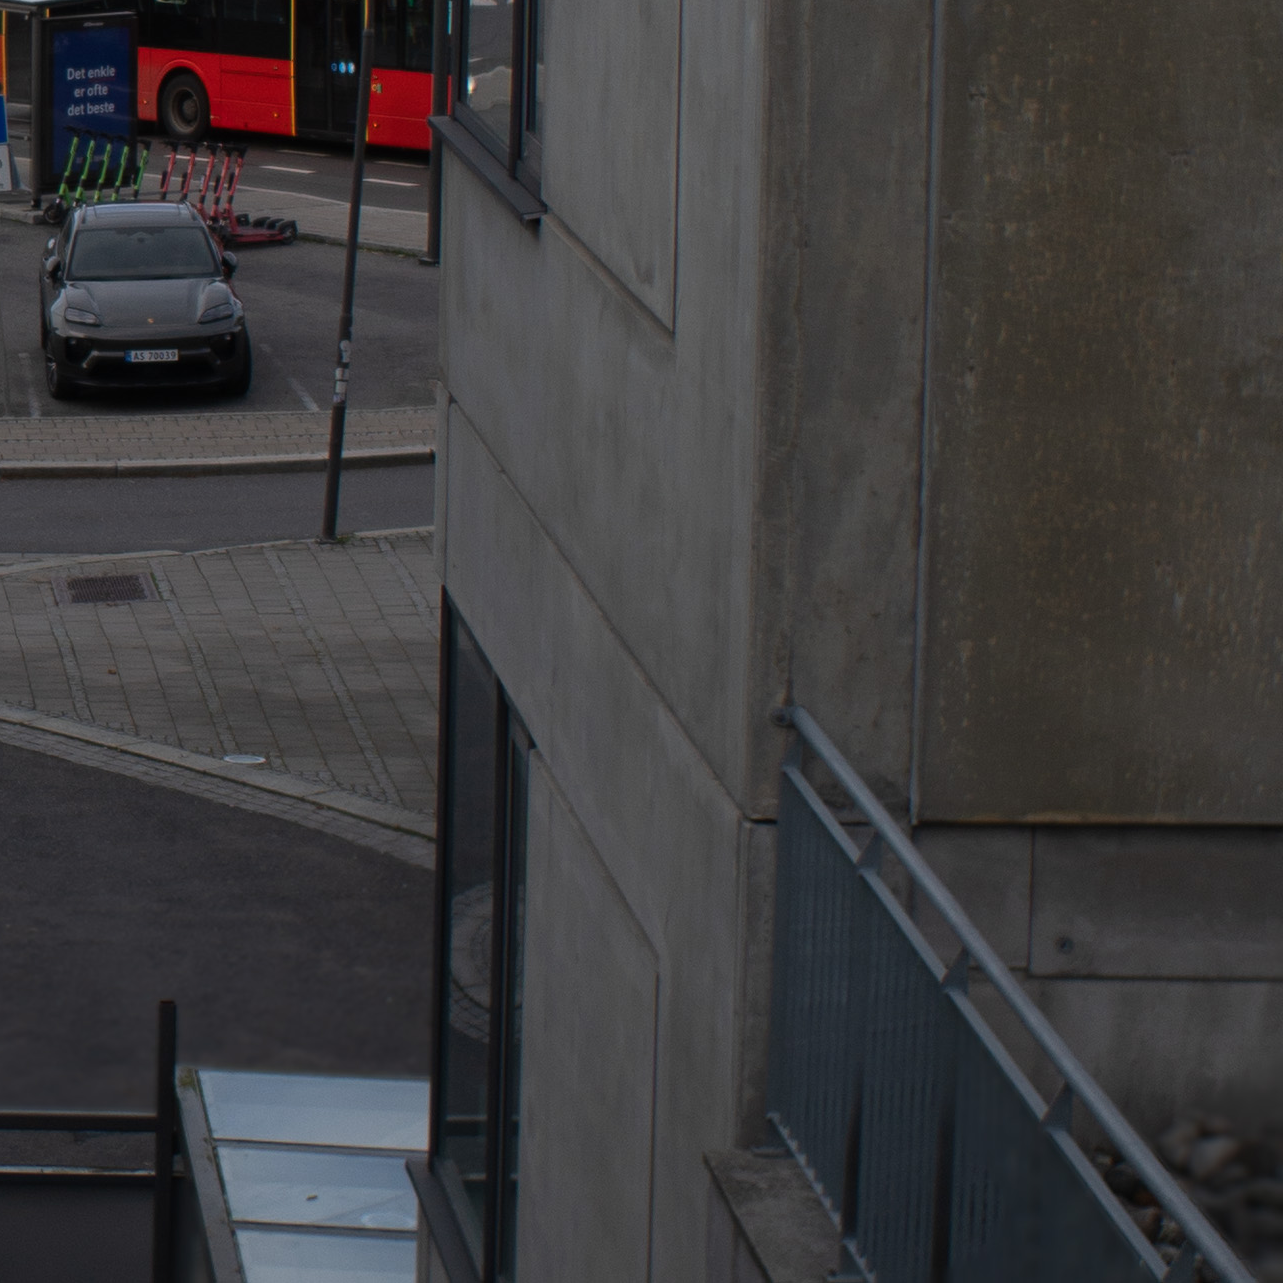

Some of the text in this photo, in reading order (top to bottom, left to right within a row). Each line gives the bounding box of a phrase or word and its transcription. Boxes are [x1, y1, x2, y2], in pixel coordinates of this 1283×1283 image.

[67, 65, 116, 80] Det enkle
[73, 83, 108, 97] er ofte
[67, 101, 115, 116] det beste
[133, 351, 177, 360] AS 70039
